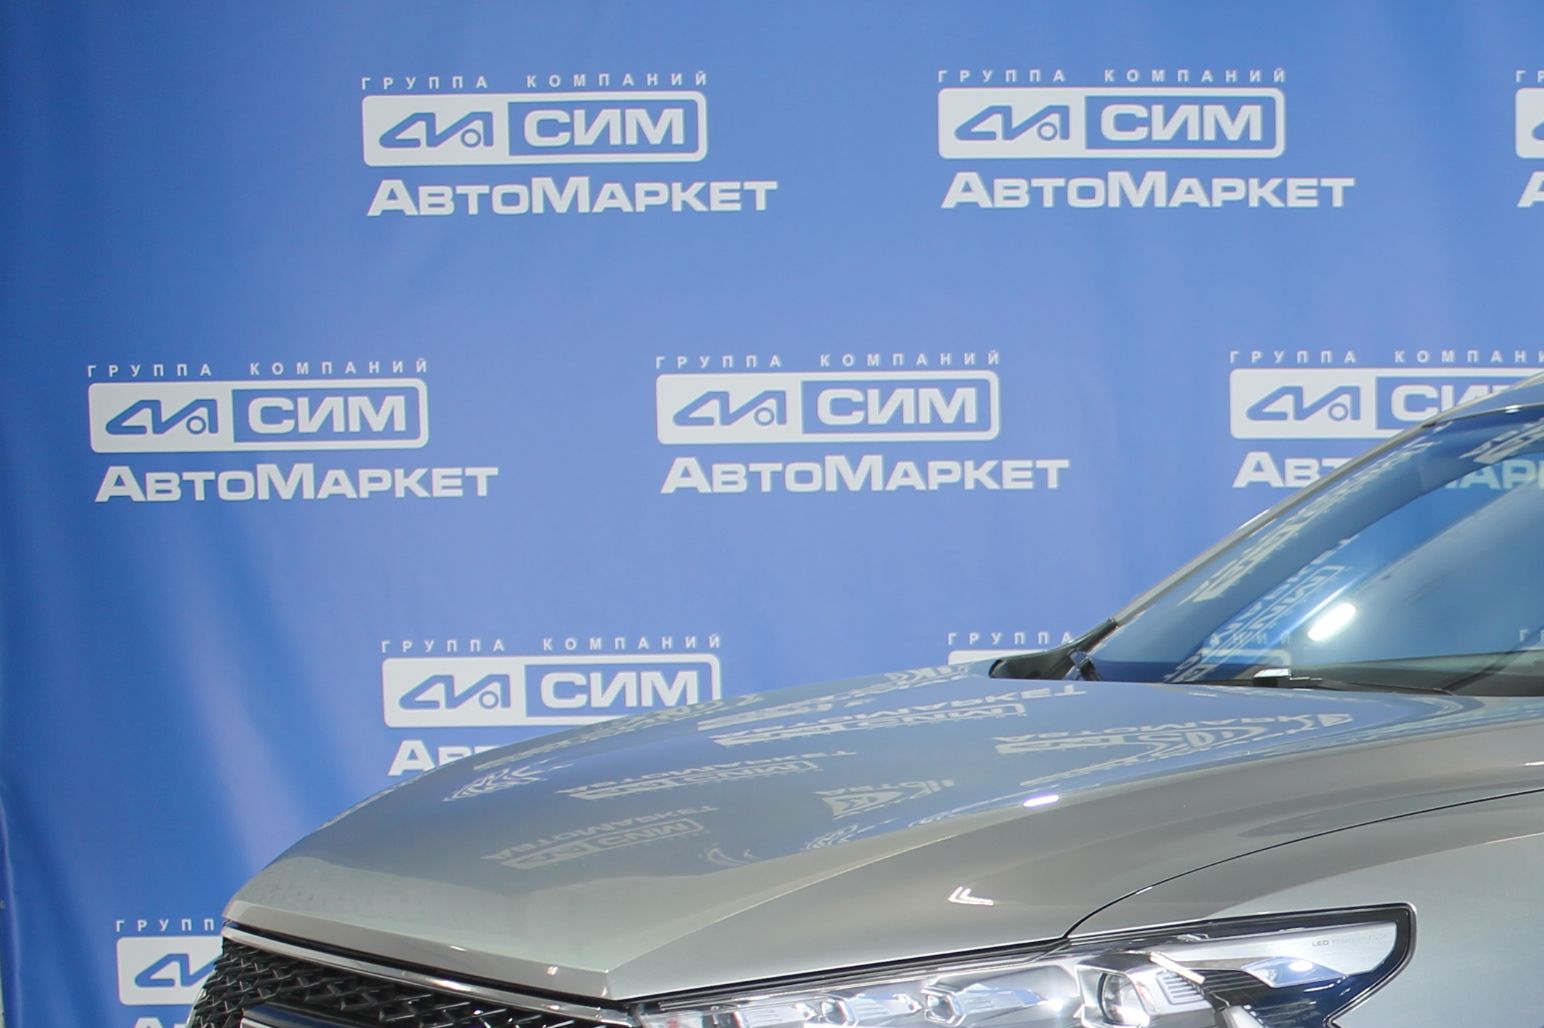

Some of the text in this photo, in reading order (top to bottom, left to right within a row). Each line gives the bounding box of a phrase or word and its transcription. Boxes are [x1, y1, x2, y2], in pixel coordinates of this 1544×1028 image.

[362, 71, 706, 90] ГРУППА КОМПАНИЙ
[938, 68, 1285, 82] ГРУППА КОМПАНИЙ
[524, 108, 683, 146] СИМ
[1101, 104, 1261, 140] СИМ
[656, 351, 999, 368] ГРУППА КОМПАНИЙ
[1230, 350, 1356, 363] ГРУППА
[88, 359, 427, 377] ГРУППА КОМПАНИЙ
[818, 388, 976, 425] СИМ
[1391, 384, 1516, 422] СИ
[249, 395, 405, 433] СИМ
[382, 634, 720, 652] ГРУППА КОМПАНИЙ
[948, 633, 1073, 646] ГРУППА
[541, 671, 698, 706] СИМ
[116, 919, 214, 932] ГРУПП
